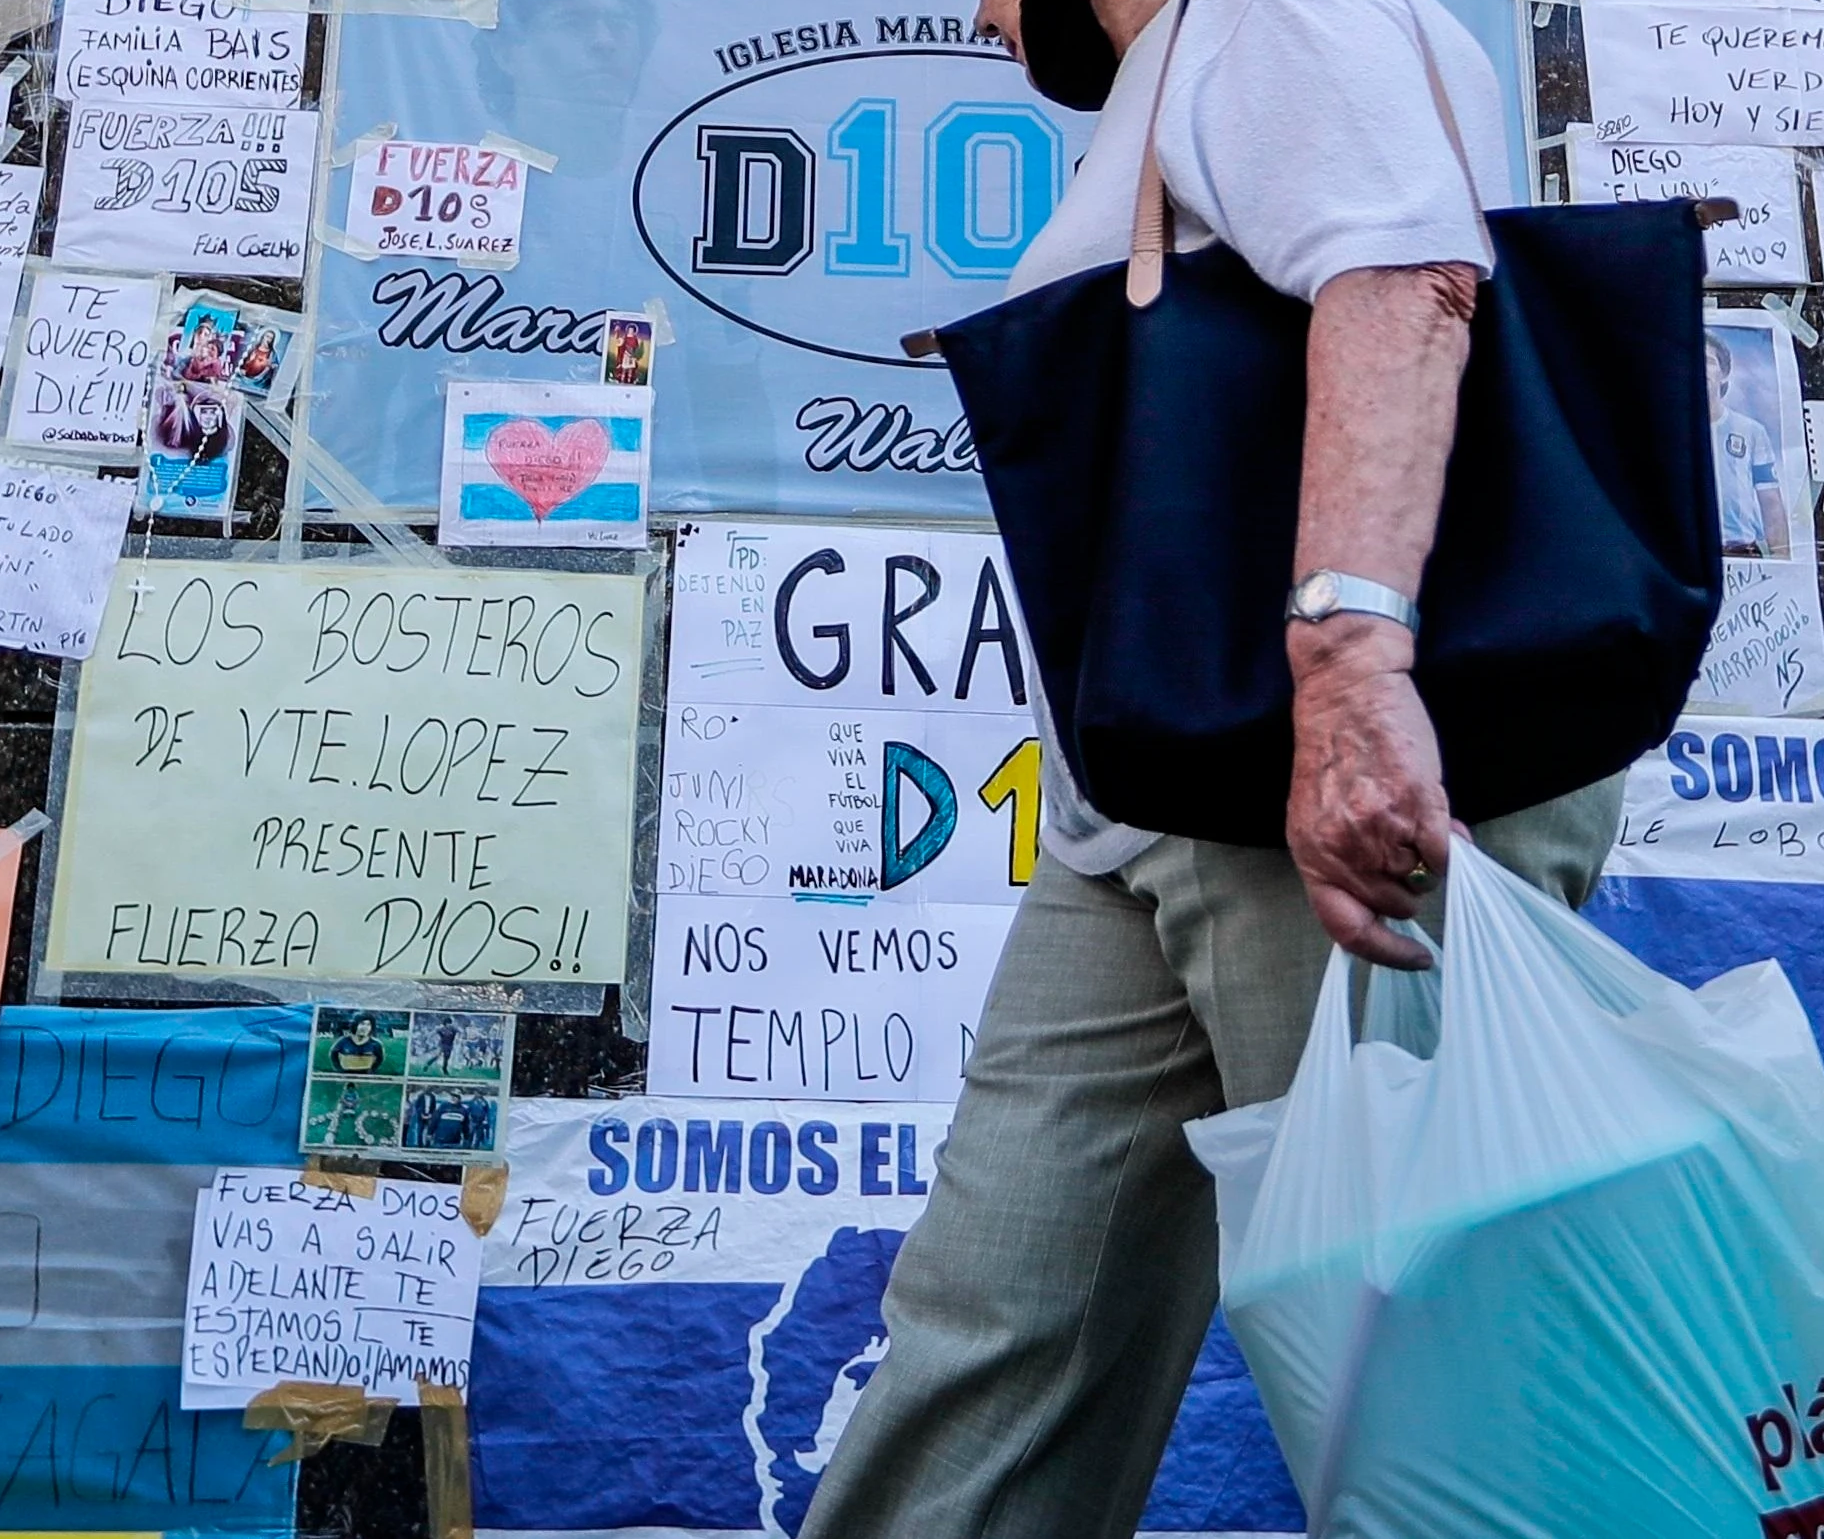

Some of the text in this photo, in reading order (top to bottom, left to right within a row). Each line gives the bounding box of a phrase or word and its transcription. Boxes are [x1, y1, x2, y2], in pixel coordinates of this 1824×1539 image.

[713, 11, 1016, 75] IGLESIA MARA
[1648, 23, 1689, 51] TE
[691, 98, 1084, 279] D10
[60, 284, 121, 318] TE
[25, 316, 148, 369] QUIERO
[304, 586, 622, 698] BOSTEROS
[253, 815, 497, 891] PRESENTE
[106, 903, 321, 967] FUERZA
[683, 926, 959, 976] NOS VEMOS
[671, 1006, 913, 1092] TEMPLO
